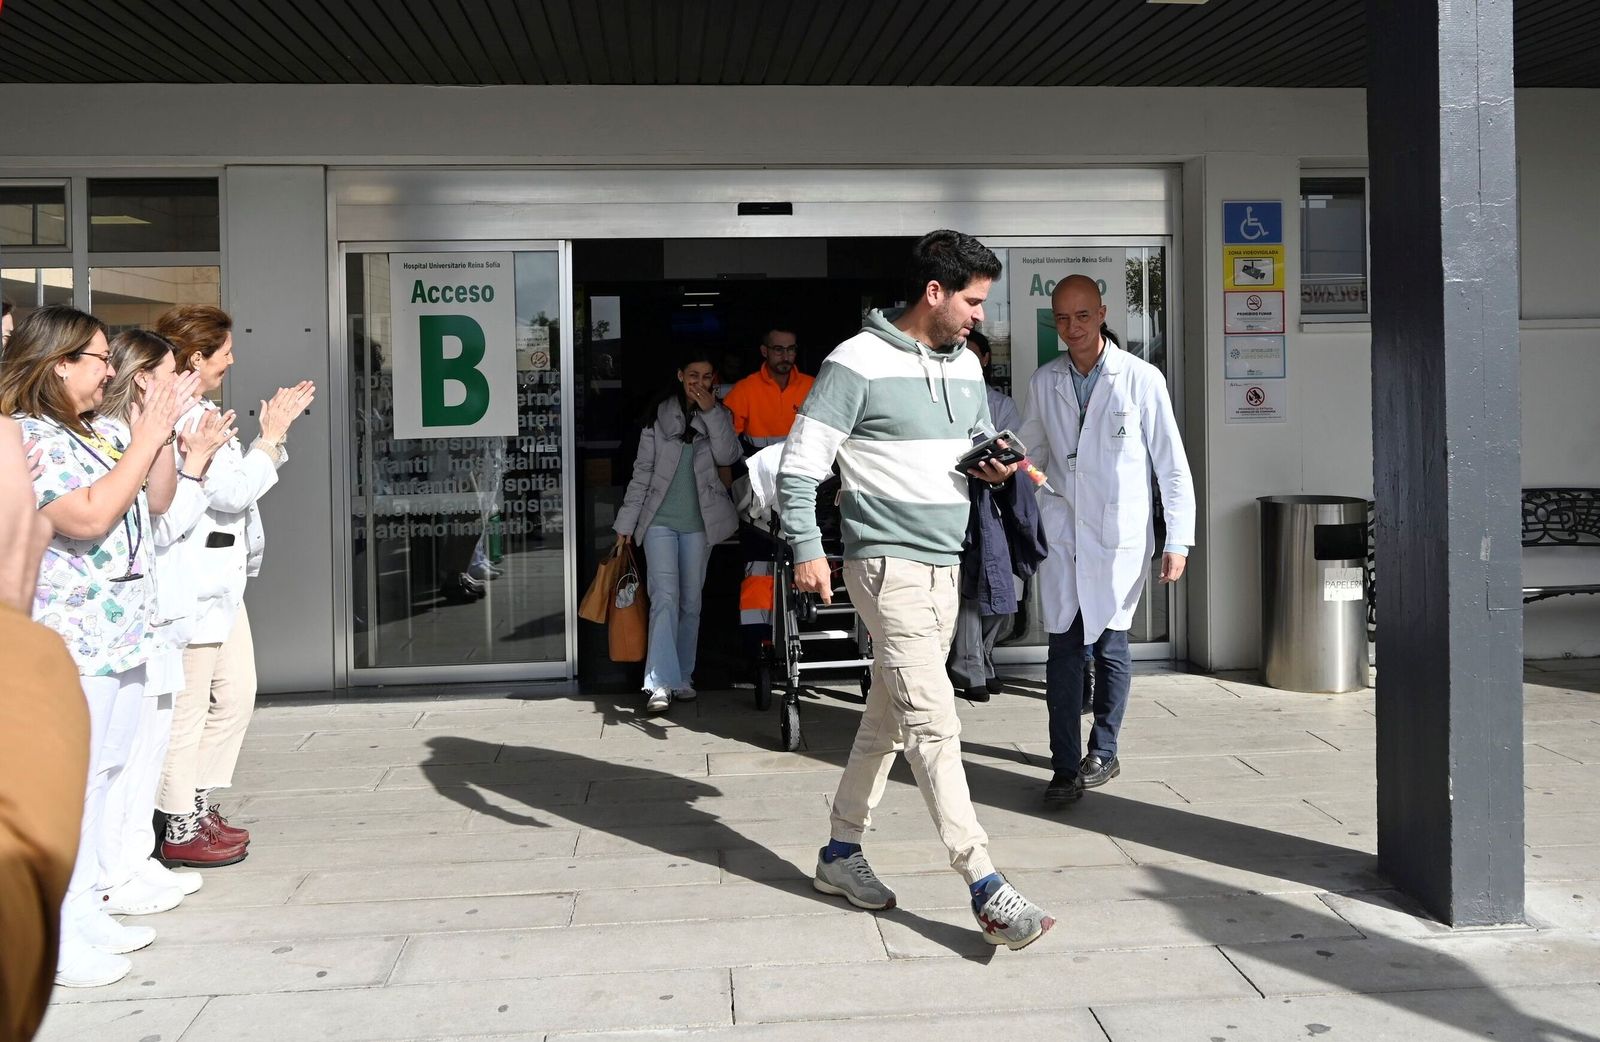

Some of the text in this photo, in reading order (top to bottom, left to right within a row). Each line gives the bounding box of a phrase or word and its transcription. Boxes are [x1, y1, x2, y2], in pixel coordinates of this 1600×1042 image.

[403, 262, 428, 270] Hospital
[467, 261, 484, 269] Reina
[1022, 256, 1045, 264] Hospital
[411, 279, 495, 303] Acceso
[1029, 273, 1107, 297] Aco
[419, 315, 490, 427] B
